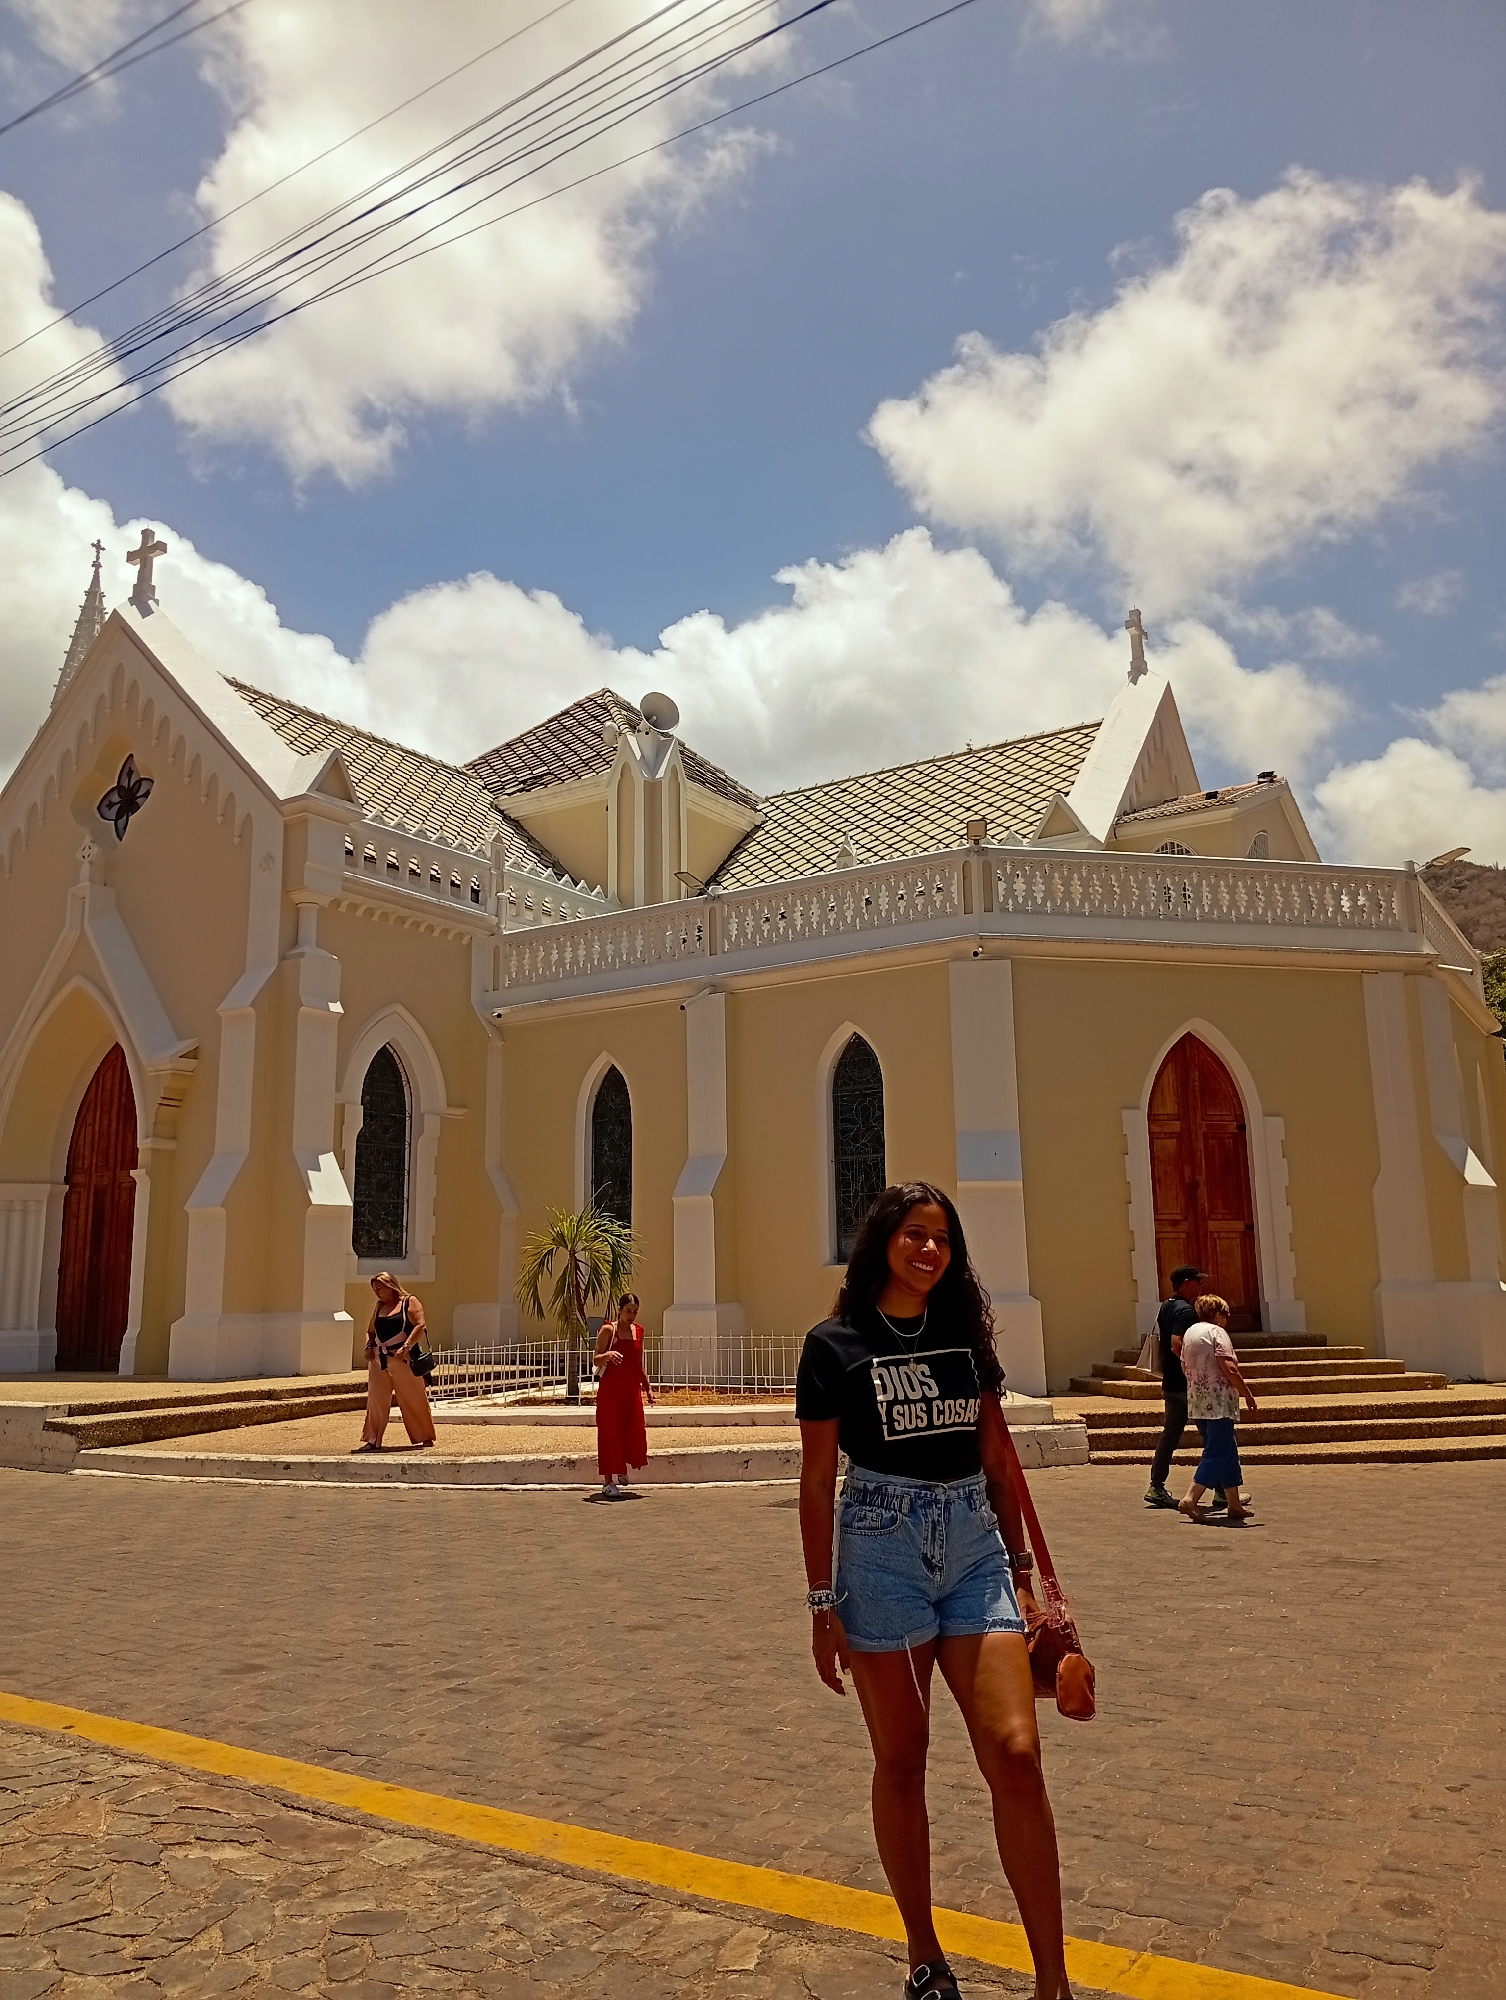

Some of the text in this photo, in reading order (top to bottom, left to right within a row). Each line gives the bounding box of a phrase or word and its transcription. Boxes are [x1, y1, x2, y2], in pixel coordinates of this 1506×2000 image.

[870, 1364, 940, 1401] DIOS
[877, 1402, 887, 1423] Y
[892, 1402, 928, 1431] SUS
